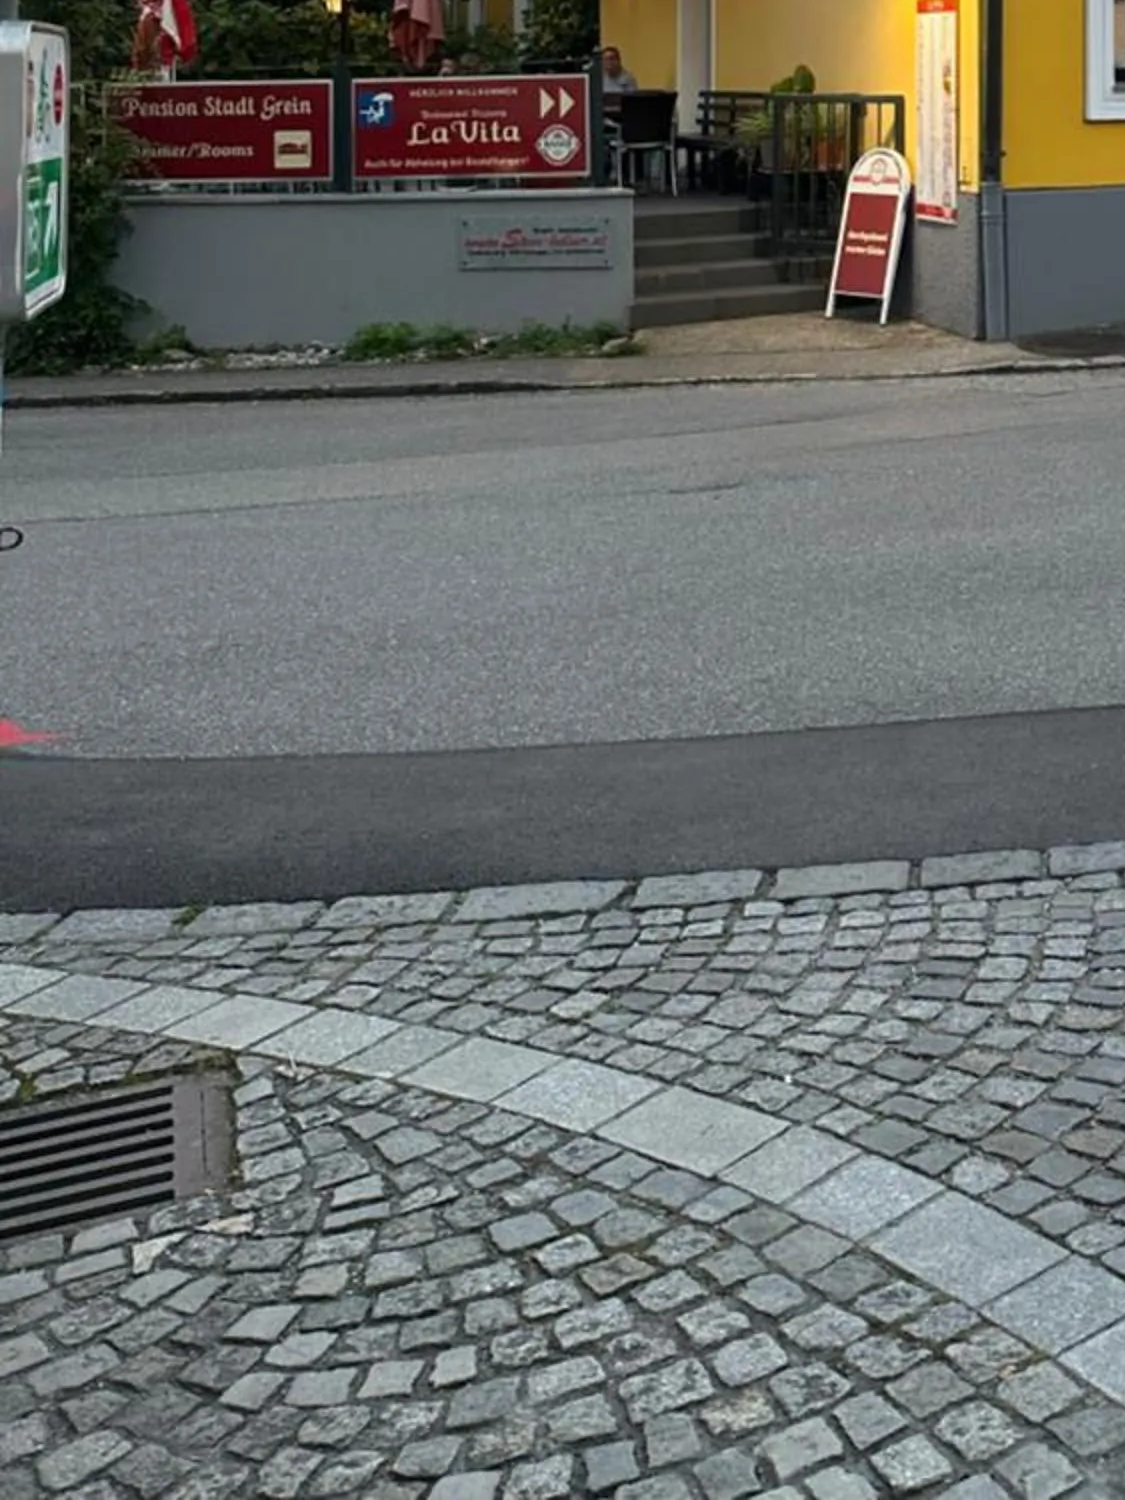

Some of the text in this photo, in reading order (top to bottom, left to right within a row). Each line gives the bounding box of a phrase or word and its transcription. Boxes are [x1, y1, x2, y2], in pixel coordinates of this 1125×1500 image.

[121, 95, 312, 121] Pension Stadt Grein
[407, 120, 522, 147] La Vita
